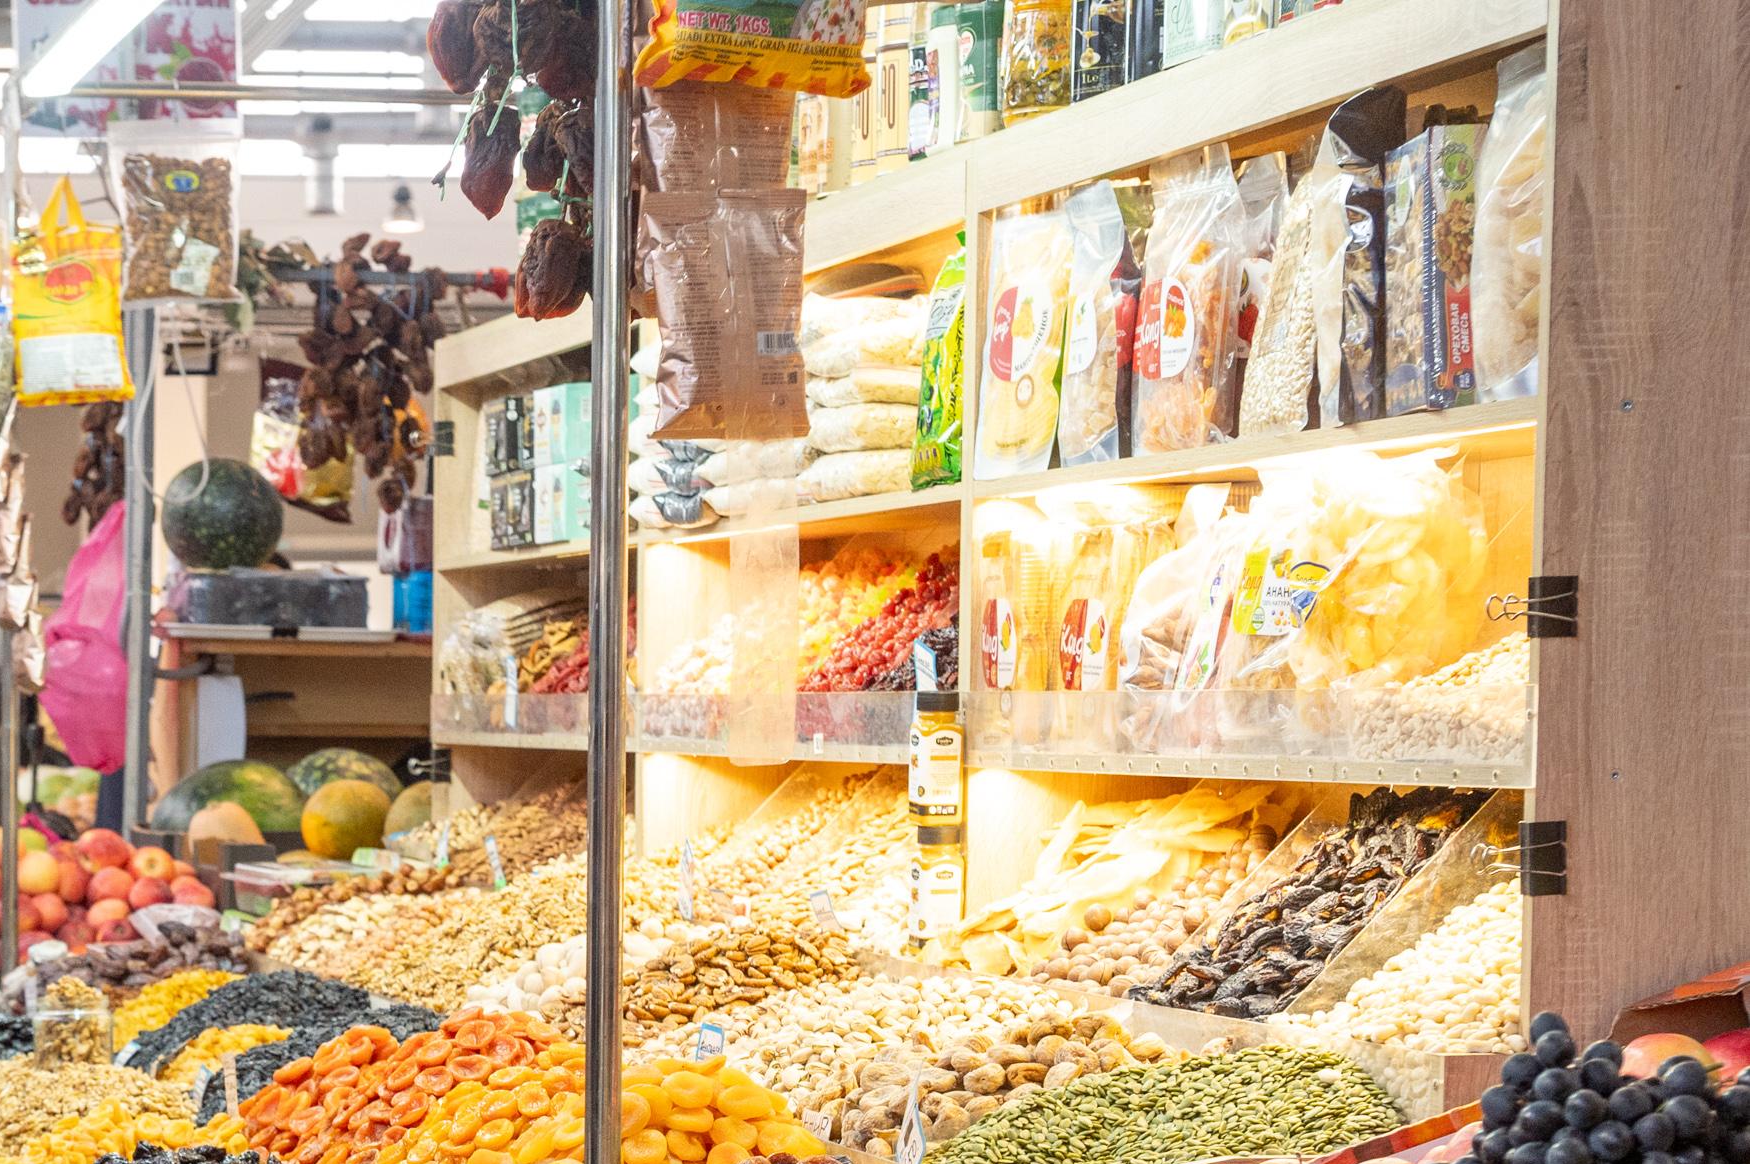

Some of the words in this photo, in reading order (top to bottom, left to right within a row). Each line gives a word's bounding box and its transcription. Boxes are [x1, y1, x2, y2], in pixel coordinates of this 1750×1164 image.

[677, 11, 707, 28] NET
[708, 14, 731, 31] WT.
[735, 15, 773, 35] 1KGS.
[704, 32, 733, 45] EXTRA
[734, 35, 759, 48] LONG
[1450, 303, 1463, 365] ОРЕХОВАЯ
[1460, 312, 1471, 354] СМЕСЬ
